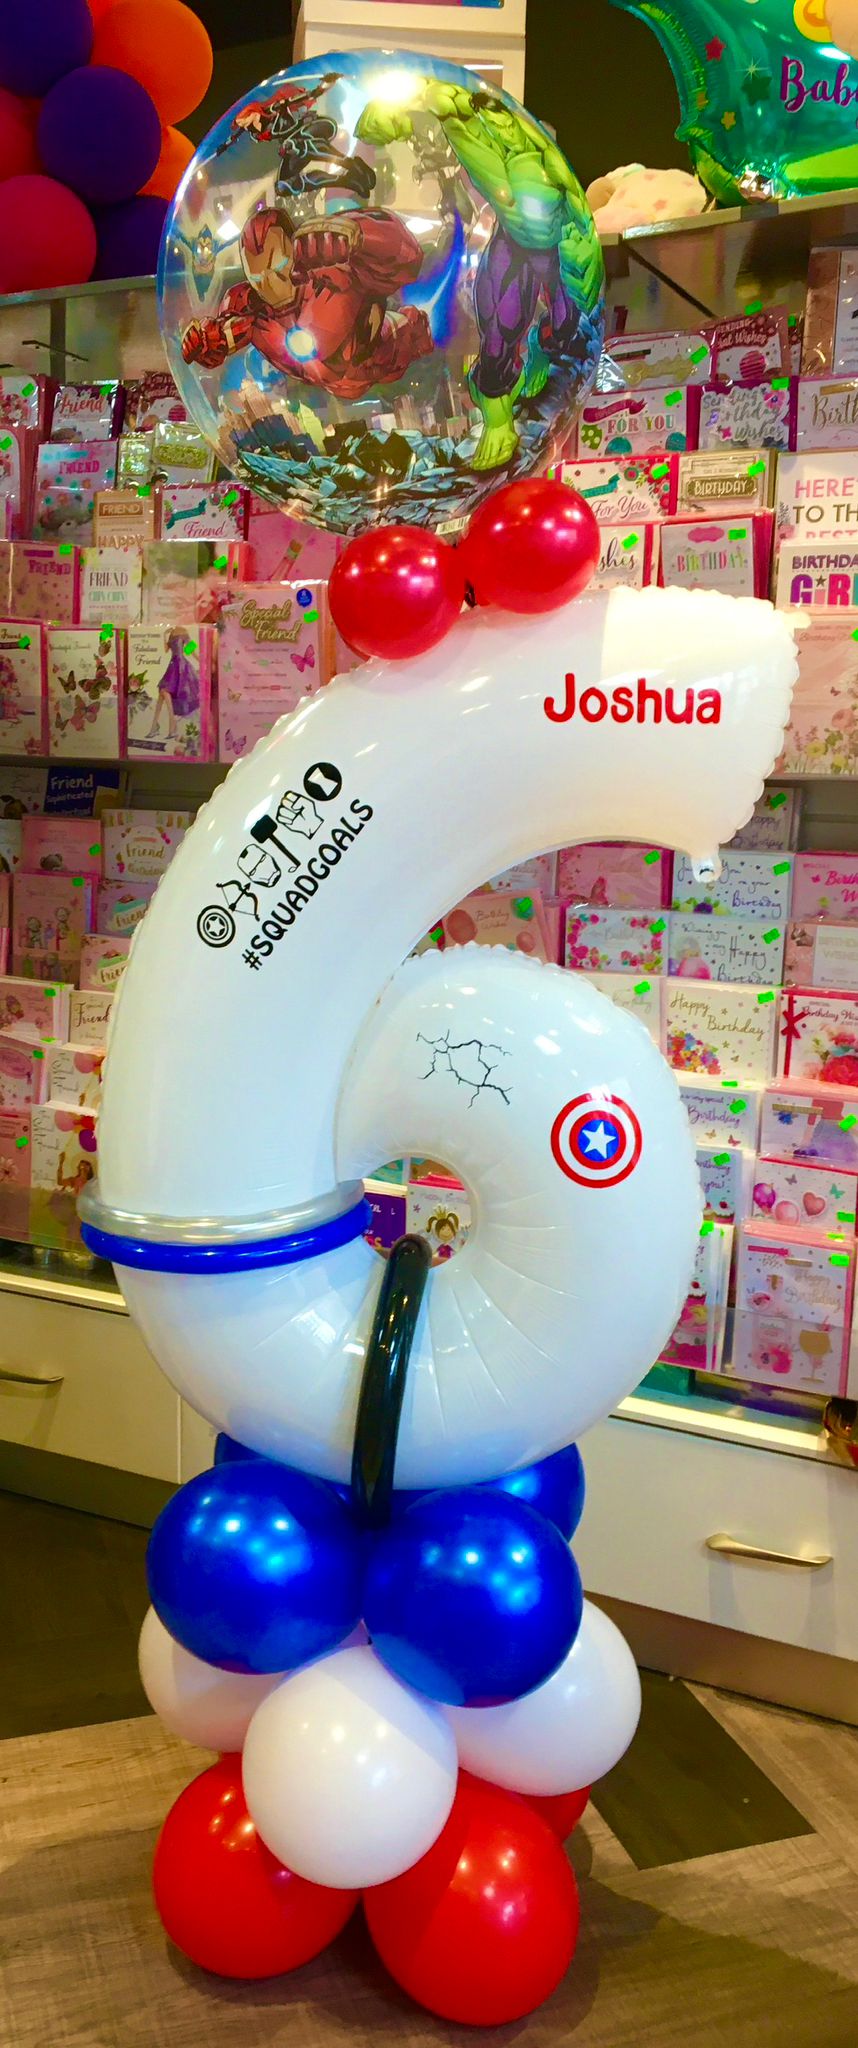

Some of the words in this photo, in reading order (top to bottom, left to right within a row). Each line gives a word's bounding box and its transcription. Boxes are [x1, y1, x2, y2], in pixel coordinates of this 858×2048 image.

[780, 56, 858, 113] Bab
[607, 418, 640, 434] FOR
[645, 414, 674, 431] YOU
[694, 479, 747, 496] BIRTHDAY
[102, 503, 140, 516] FRIEND
[618, 495, 649, 519] You
[793, 505, 825, 524] TO
[184, 520, 226, 538] Friend
[600, 536, 635, 572] shes
[677, 551, 745, 572] BIRTHDAY
[28, 559, 71, 576] FRIEND
[89, 572, 128, 587] FRIEND
[240, 599, 292, 628] Special
[254, 619, 304, 642] Friend
[543, 672, 722, 725] Joshua
[50, 773, 94, 790] Friend
[241, 798, 375, 972] #SQUADGOALS
[731, 889, 783, 920] Birthday
[729, 935, 767, 971] Happy
[76, 1002, 113, 1028] Friend
[670, 991, 710, 1018] Happy
[706, 1014, 766, 1042] Birthday
[687, 1104, 741, 1129] Birthday
